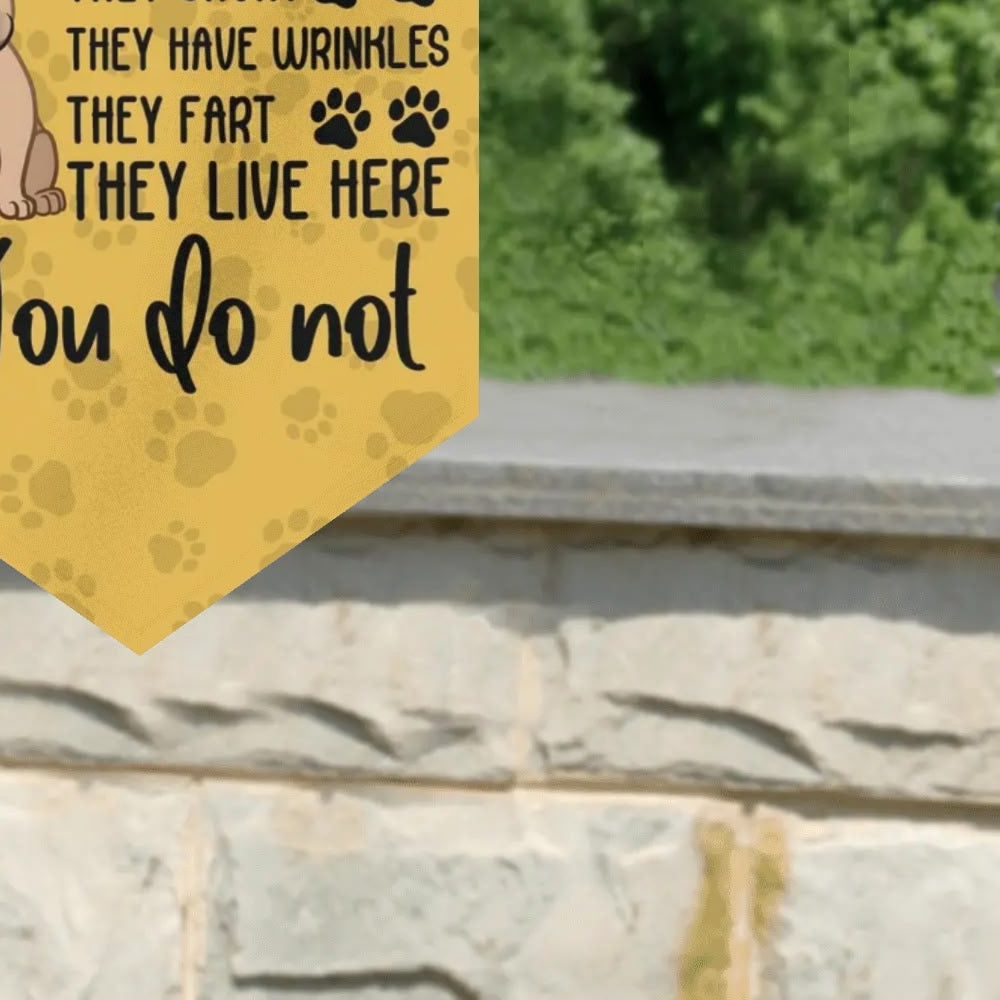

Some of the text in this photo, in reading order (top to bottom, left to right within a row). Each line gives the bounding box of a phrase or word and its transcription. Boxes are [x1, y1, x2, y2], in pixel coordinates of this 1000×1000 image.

[66, 24, 449, 71] THEY HAVE WRINKLES
[66, 95, 276, 144] THEY FART
[67, 157, 450, 221] THEY LIVE HERE
[145, 233, 256, 394] do
[291, 242, 426, 371] not
